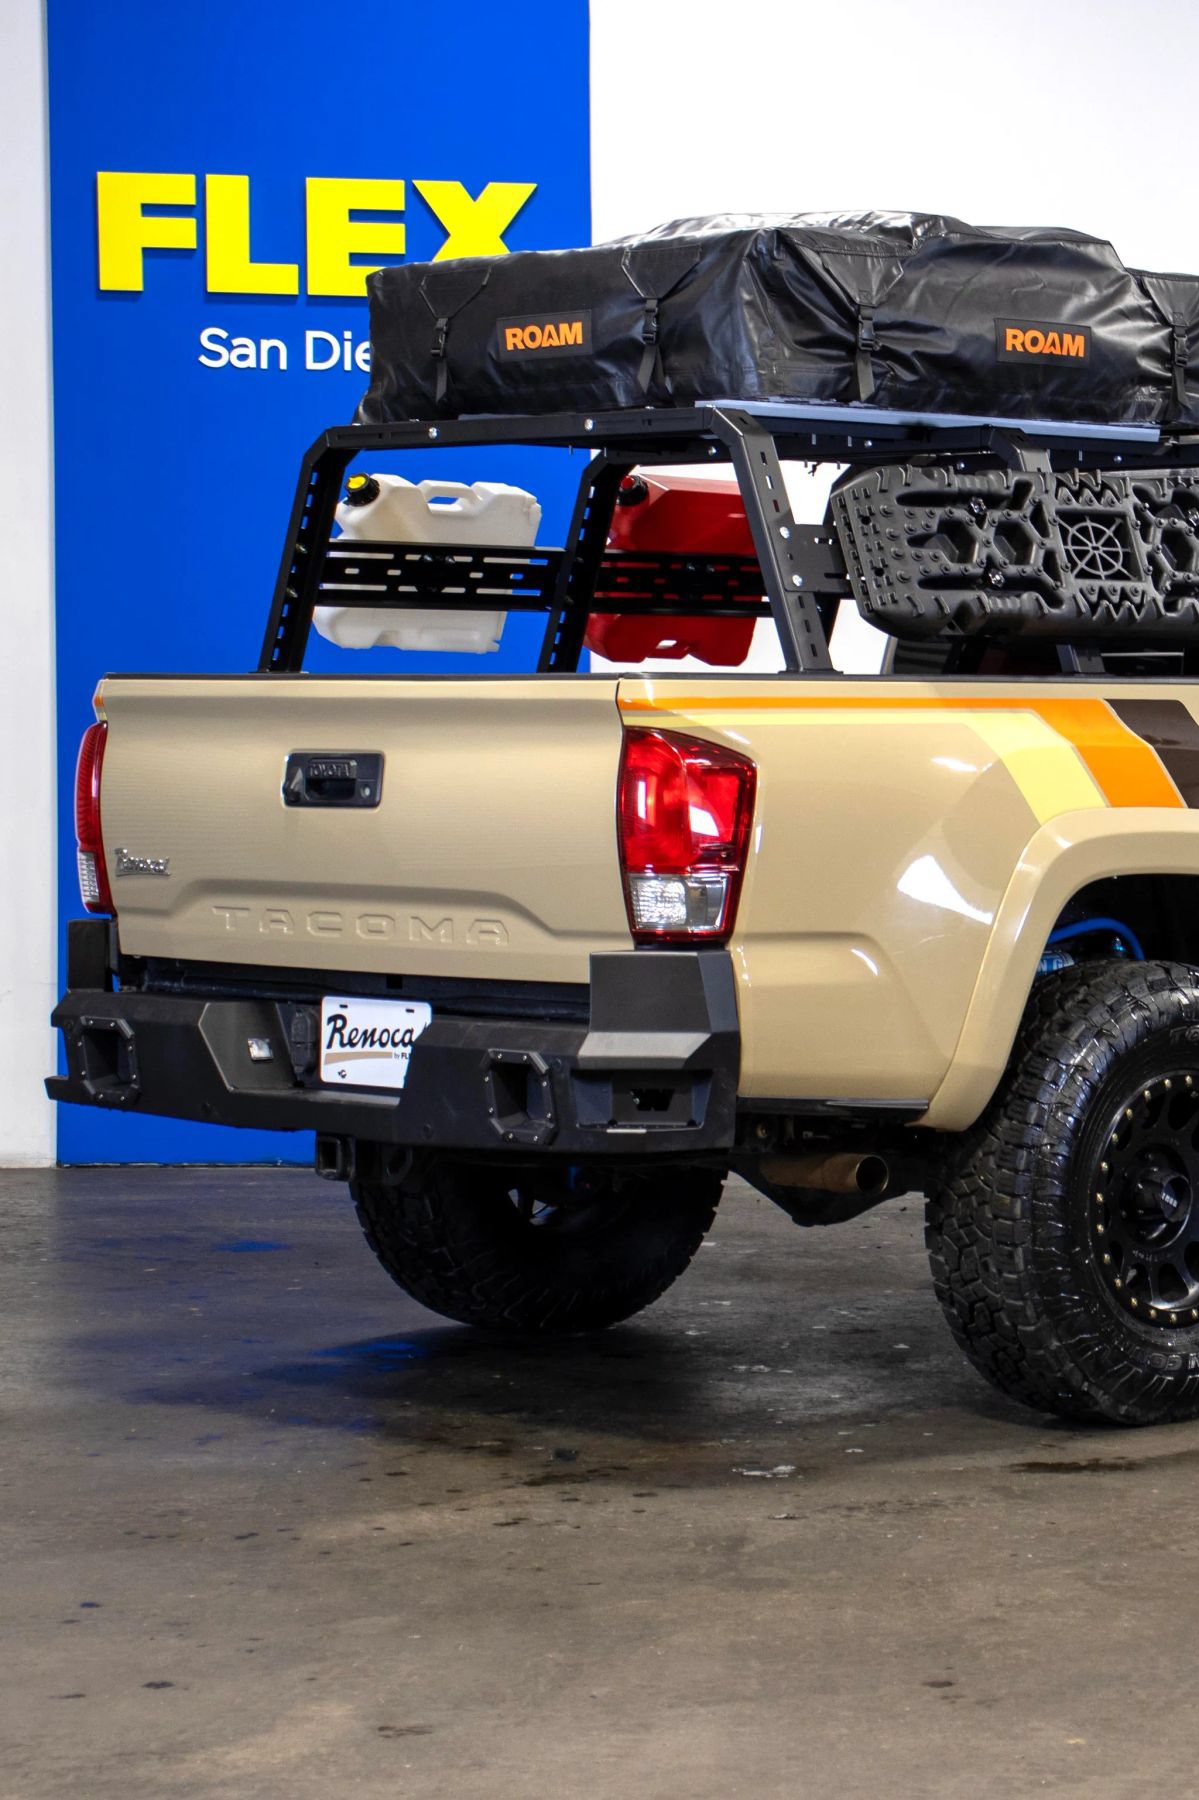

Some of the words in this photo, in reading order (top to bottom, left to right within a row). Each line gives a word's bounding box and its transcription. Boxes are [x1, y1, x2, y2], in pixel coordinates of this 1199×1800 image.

[97, 171, 538, 297] FLEX
[198, 326, 288, 370] San
[305, 330, 371, 372] Die
[505, 321, 583, 351] ROAM
[1005, 328, 1085, 358] ROAM
[211, 905, 509, 946] TACOMA
